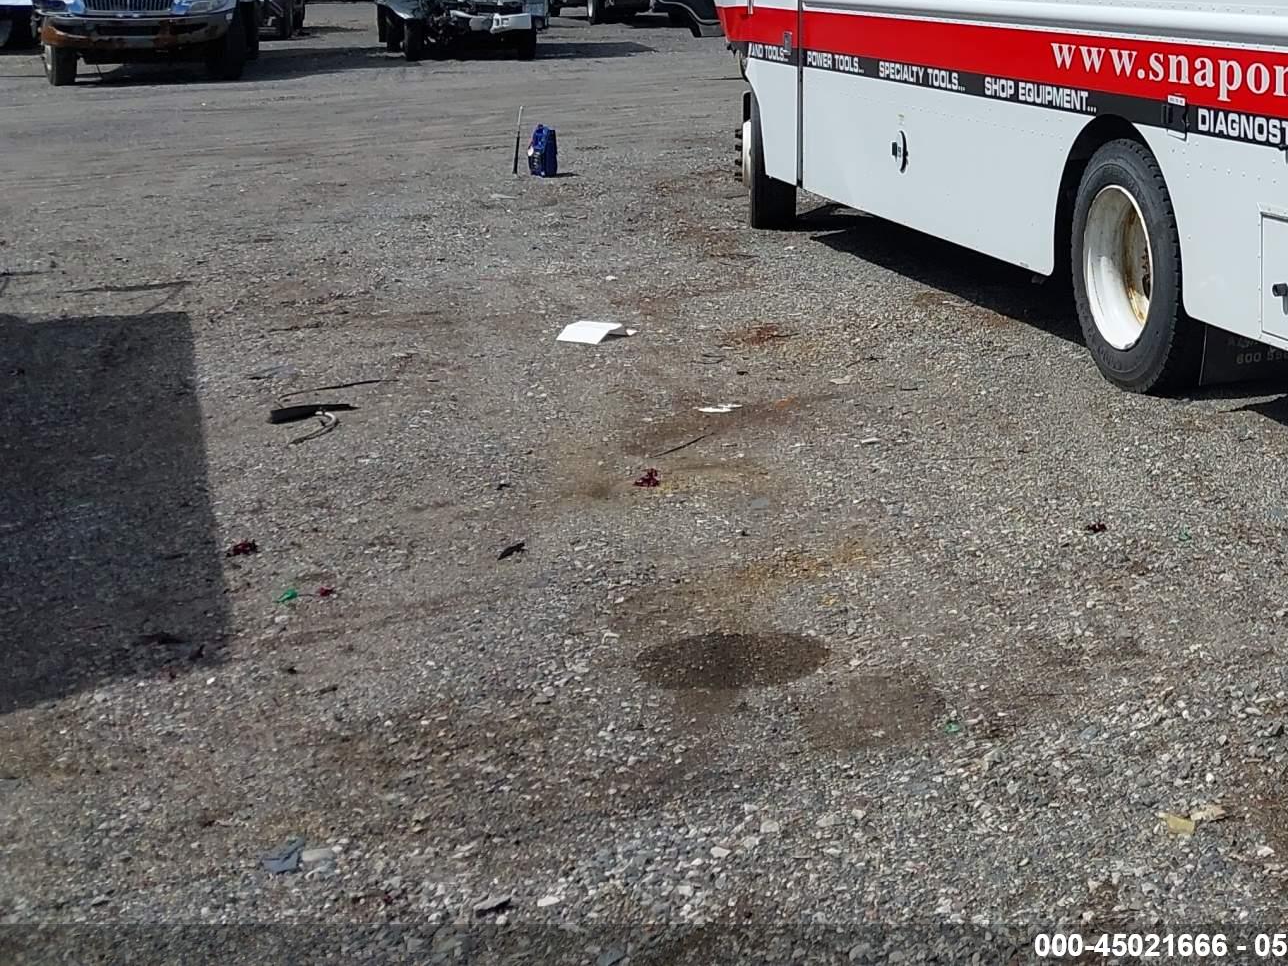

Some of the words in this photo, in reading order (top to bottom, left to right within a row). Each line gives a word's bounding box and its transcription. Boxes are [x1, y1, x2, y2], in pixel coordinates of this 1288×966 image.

[807, 51, 832, 68] POWER
[835, 55, 864, 73] TOOLS...
[879, 61, 924, 84] SPECIALTY
[927, 69, 965, 91] TOOLS...
[985, 77, 1015, 98] SHOP
[1018, 82, 1097, 113] EQUIPMENT...
